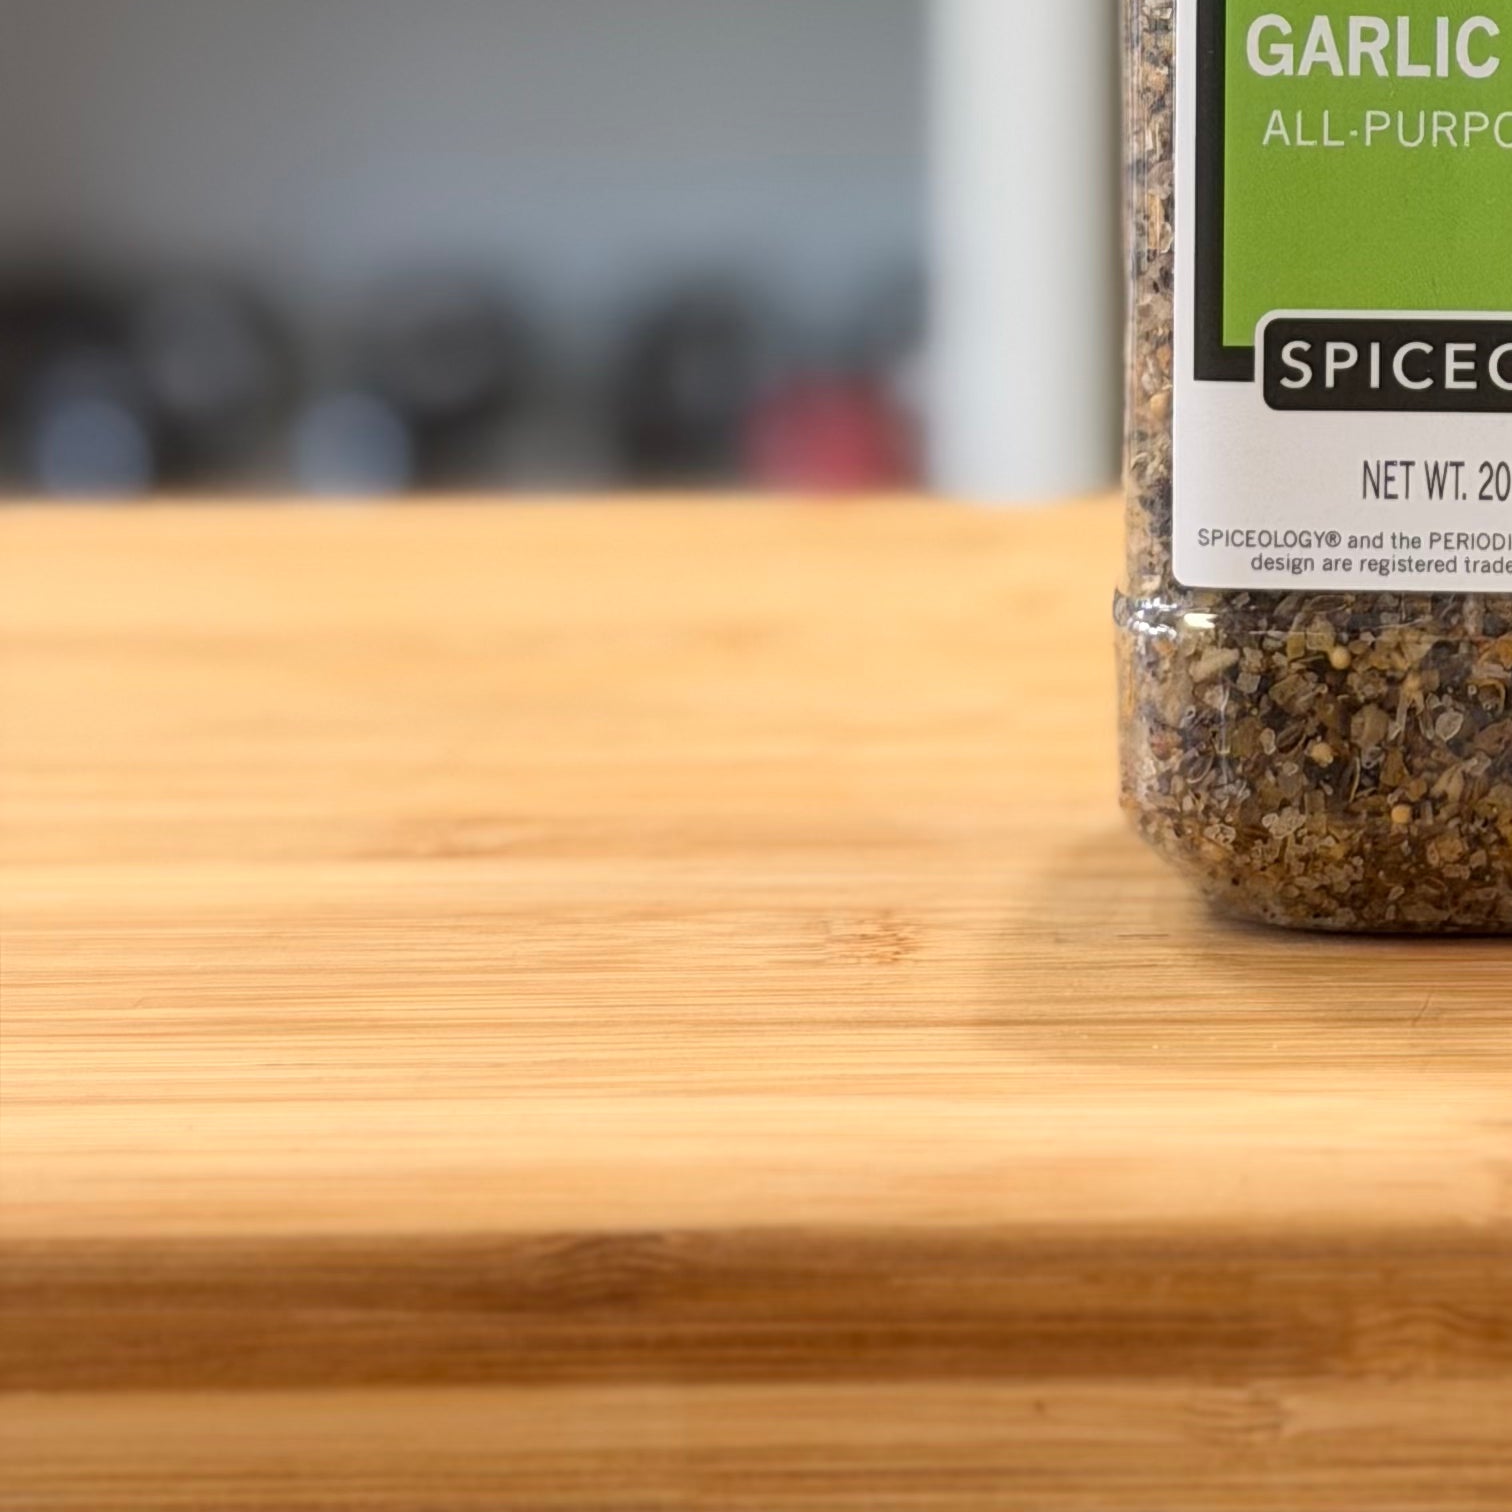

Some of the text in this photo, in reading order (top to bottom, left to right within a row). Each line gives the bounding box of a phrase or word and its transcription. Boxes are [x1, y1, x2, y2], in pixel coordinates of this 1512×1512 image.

[1245, 14, 1500, 78] GARLIC
[1362, 460, 1416, 500] NET
[1424, 461, 1468, 501] WT.
[1478, 461, 1512, 501] 20
[1197, 529, 1342, 548] SPICEOLOGY®
[1347, 530, 1383, 549] and
[1389, 530, 1422, 550] the
[1251, 553, 1315, 573] design
[1321, 557, 1353, 572] are
[1359, 555, 1458, 575] registered
